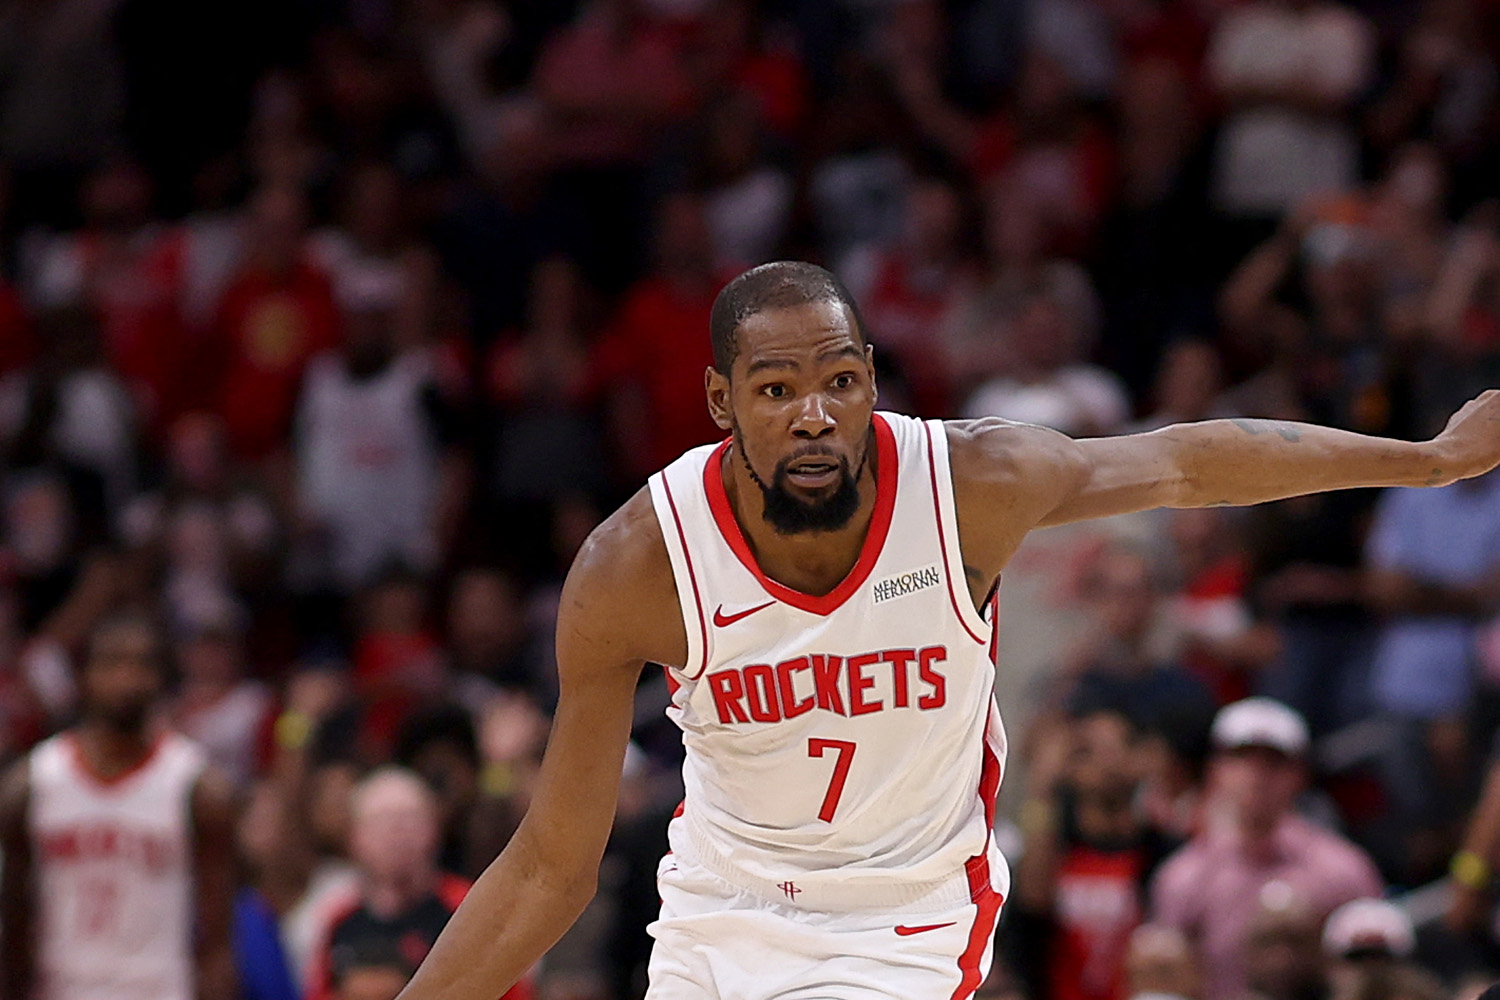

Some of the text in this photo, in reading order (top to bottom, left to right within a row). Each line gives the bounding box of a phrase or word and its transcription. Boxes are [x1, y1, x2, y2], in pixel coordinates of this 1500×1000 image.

[873, 566, 939, 592] MEMORIAL
[873, 573, 940, 603] HERMANN
[706, 643, 947, 725] ROCKETS
[807, 738, 857, 824] 7
